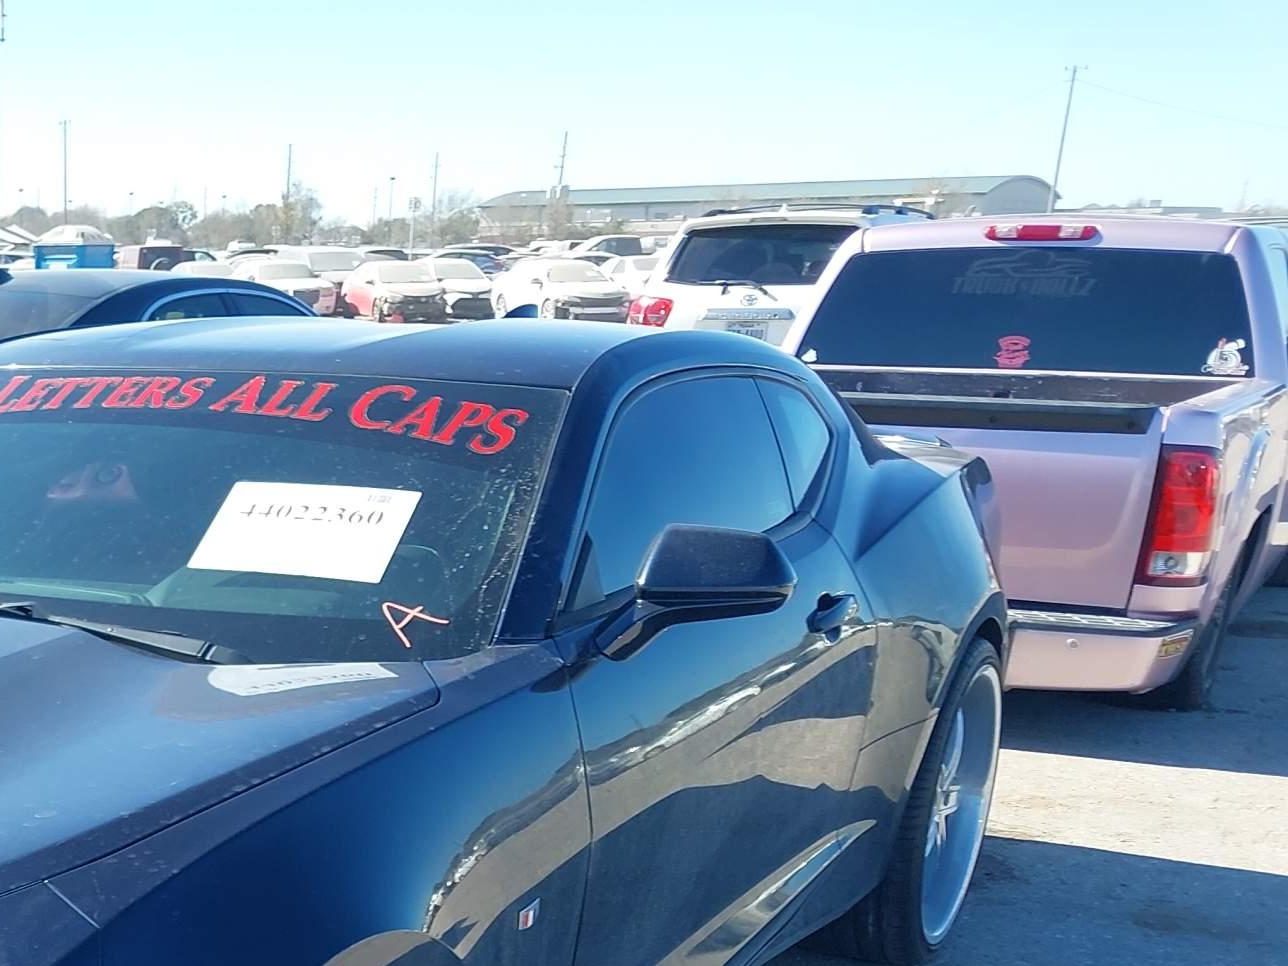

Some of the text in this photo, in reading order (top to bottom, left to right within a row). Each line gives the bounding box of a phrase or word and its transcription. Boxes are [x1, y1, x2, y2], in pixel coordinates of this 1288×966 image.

[209, 375, 339, 422] ALL
[348, 385, 529, 455] CAPS
[240, 503, 385, 525] 44022360
